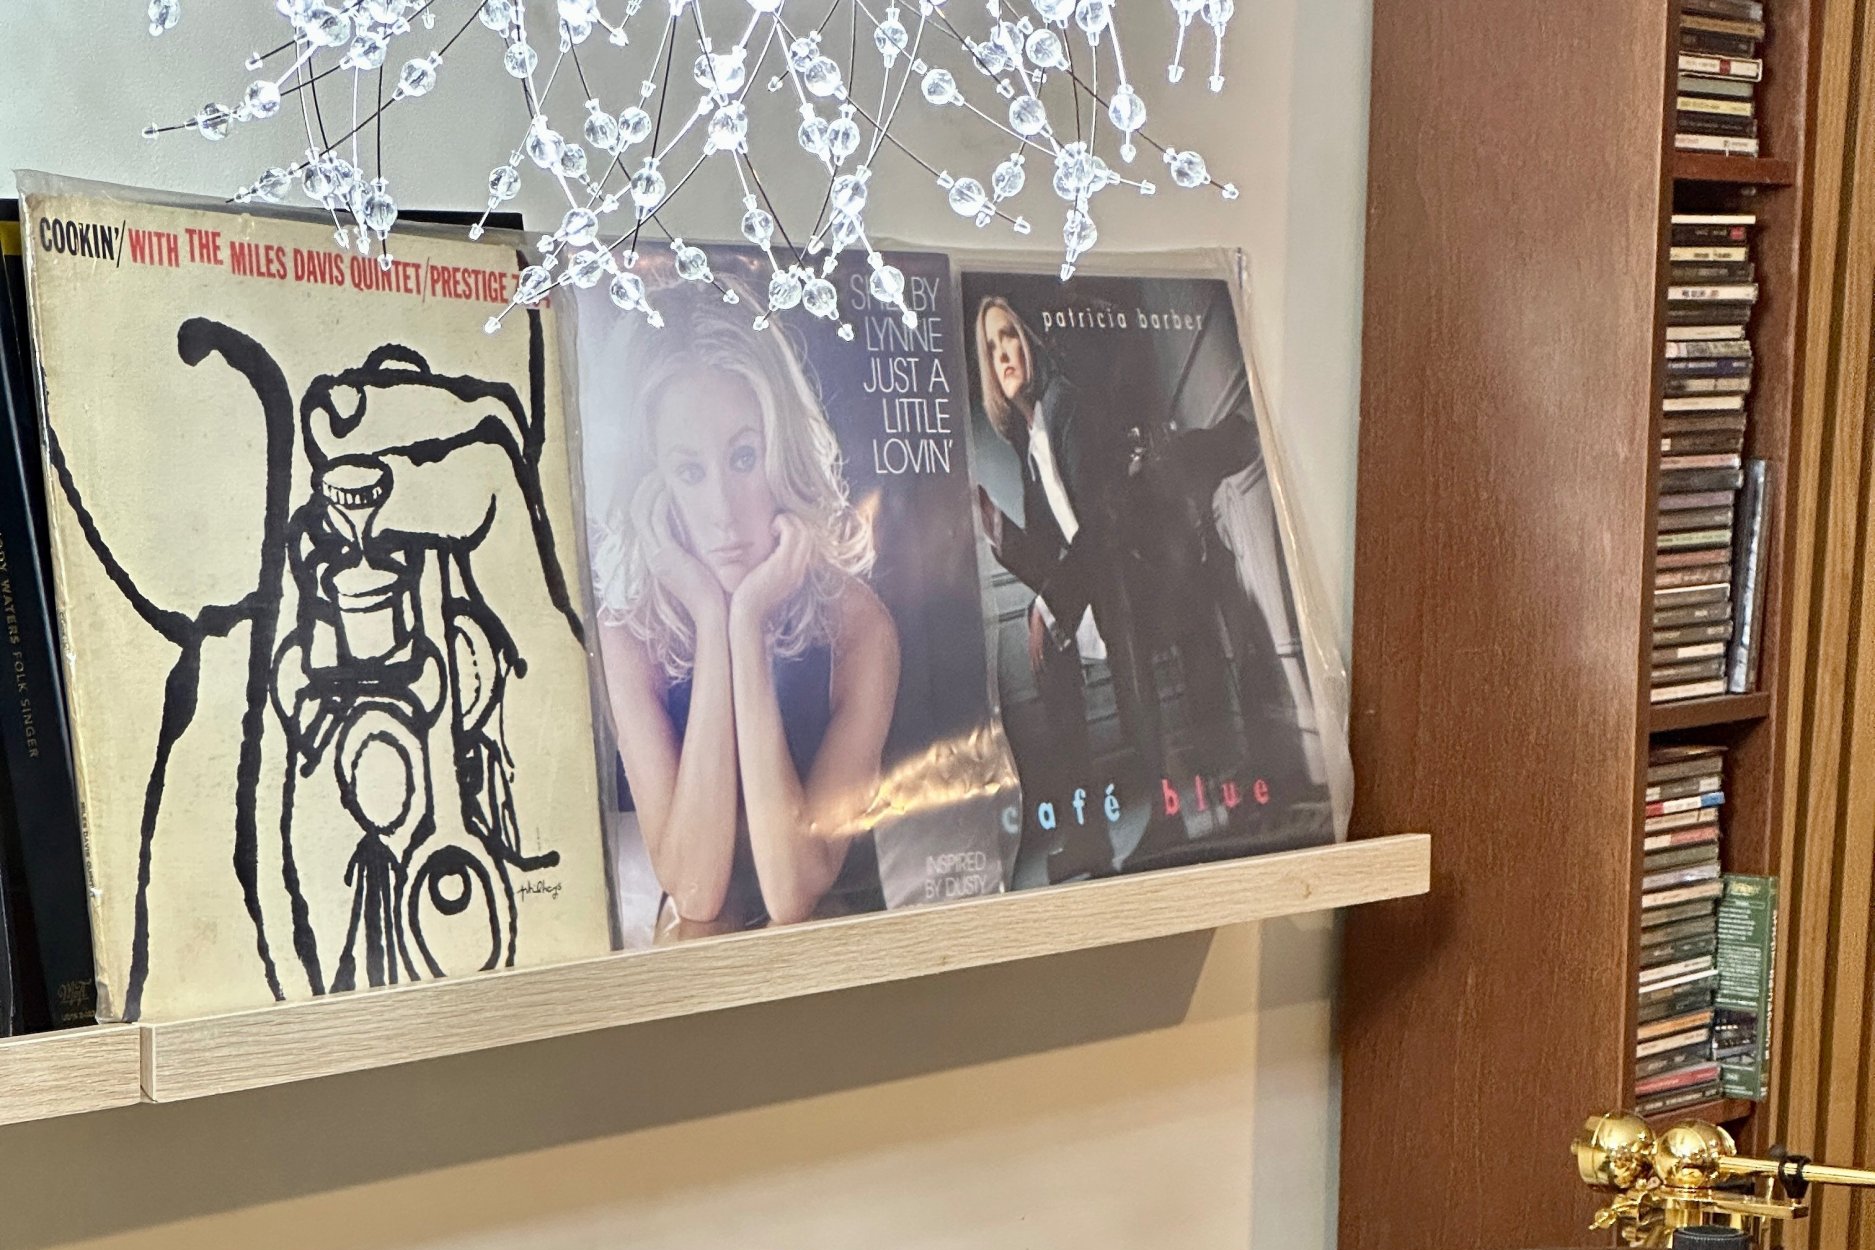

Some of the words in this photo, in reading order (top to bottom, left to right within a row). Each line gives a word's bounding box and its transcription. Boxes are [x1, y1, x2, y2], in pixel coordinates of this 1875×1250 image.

[185, 228, 224, 265] THE
[230, 241, 288, 280] MILES
[293, 248, 345, 286] DAVIS
[864, 316, 944, 352] LYNNE
[1042, 308, 1128, 332] patricia
[1136, 308, 1203, 330] barber
[863, 357, 919, 393] JUST
[928, 358, 950, 393] A
[882, 398, 951, 433] LITTLE
[872, 438, 953, 474] LOVIN'
[2, 579, 21, 644] WATERS
[12, 651, 28, 693] FOLK
[20, 698, 39, 757] SINGER
[1002, 783, 1121, 834] café
[1161, 775, 1270, 816] blue
[926, 851, 986, 876] INSPIRED
[925, 879, 940, 898] BY
[945, 874, 987, 897] DUSTY
